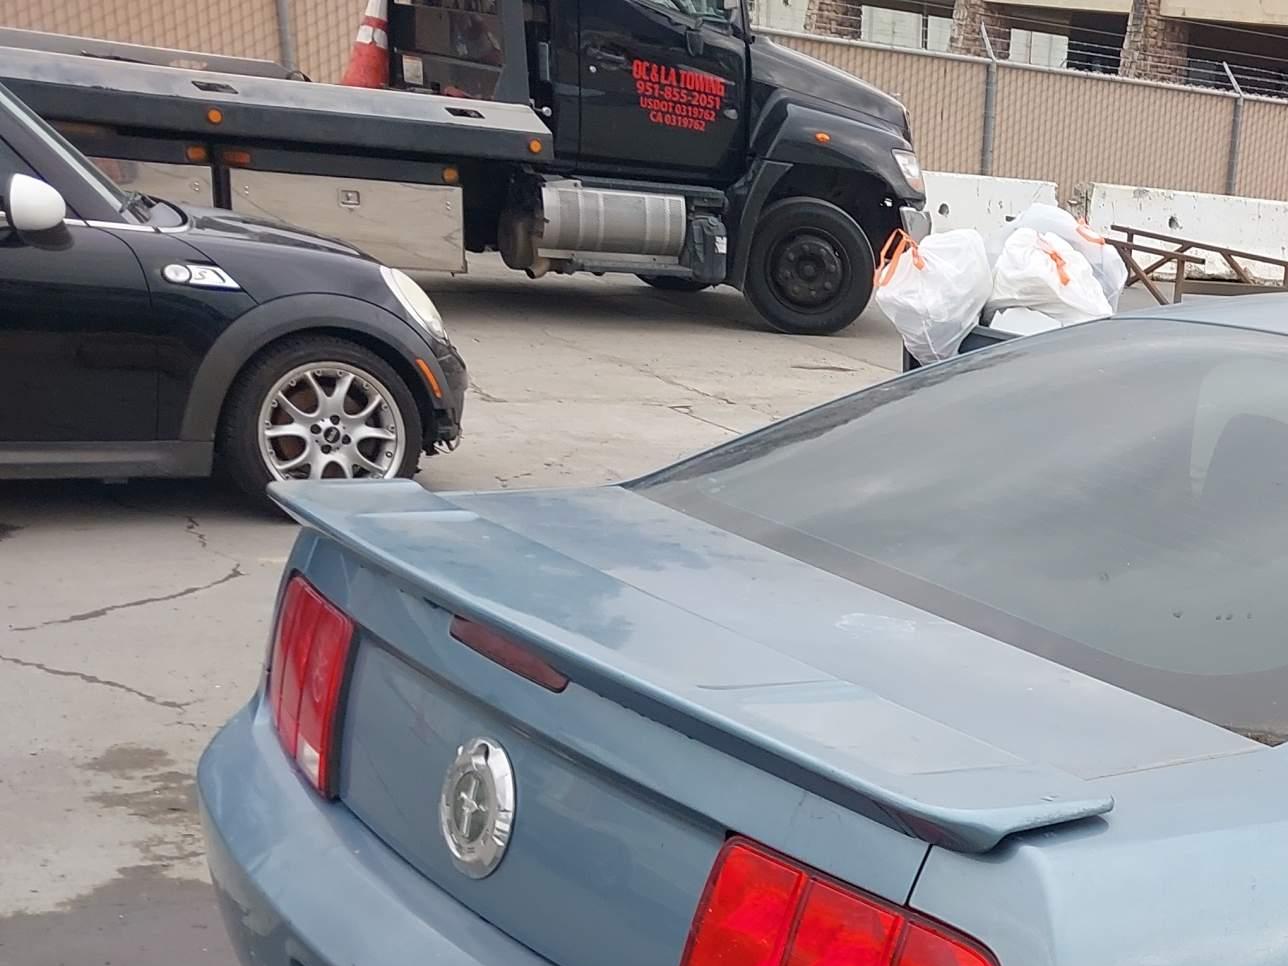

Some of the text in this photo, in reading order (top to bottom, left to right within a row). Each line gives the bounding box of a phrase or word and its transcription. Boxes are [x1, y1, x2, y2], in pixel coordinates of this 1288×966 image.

[636, 81, 720, 110] 951-855-2051
[680, 69, 725, 96] TOWING
[640, 96, 716, 121] USDOT 0319762
[649, 111, 663, 123] CA
